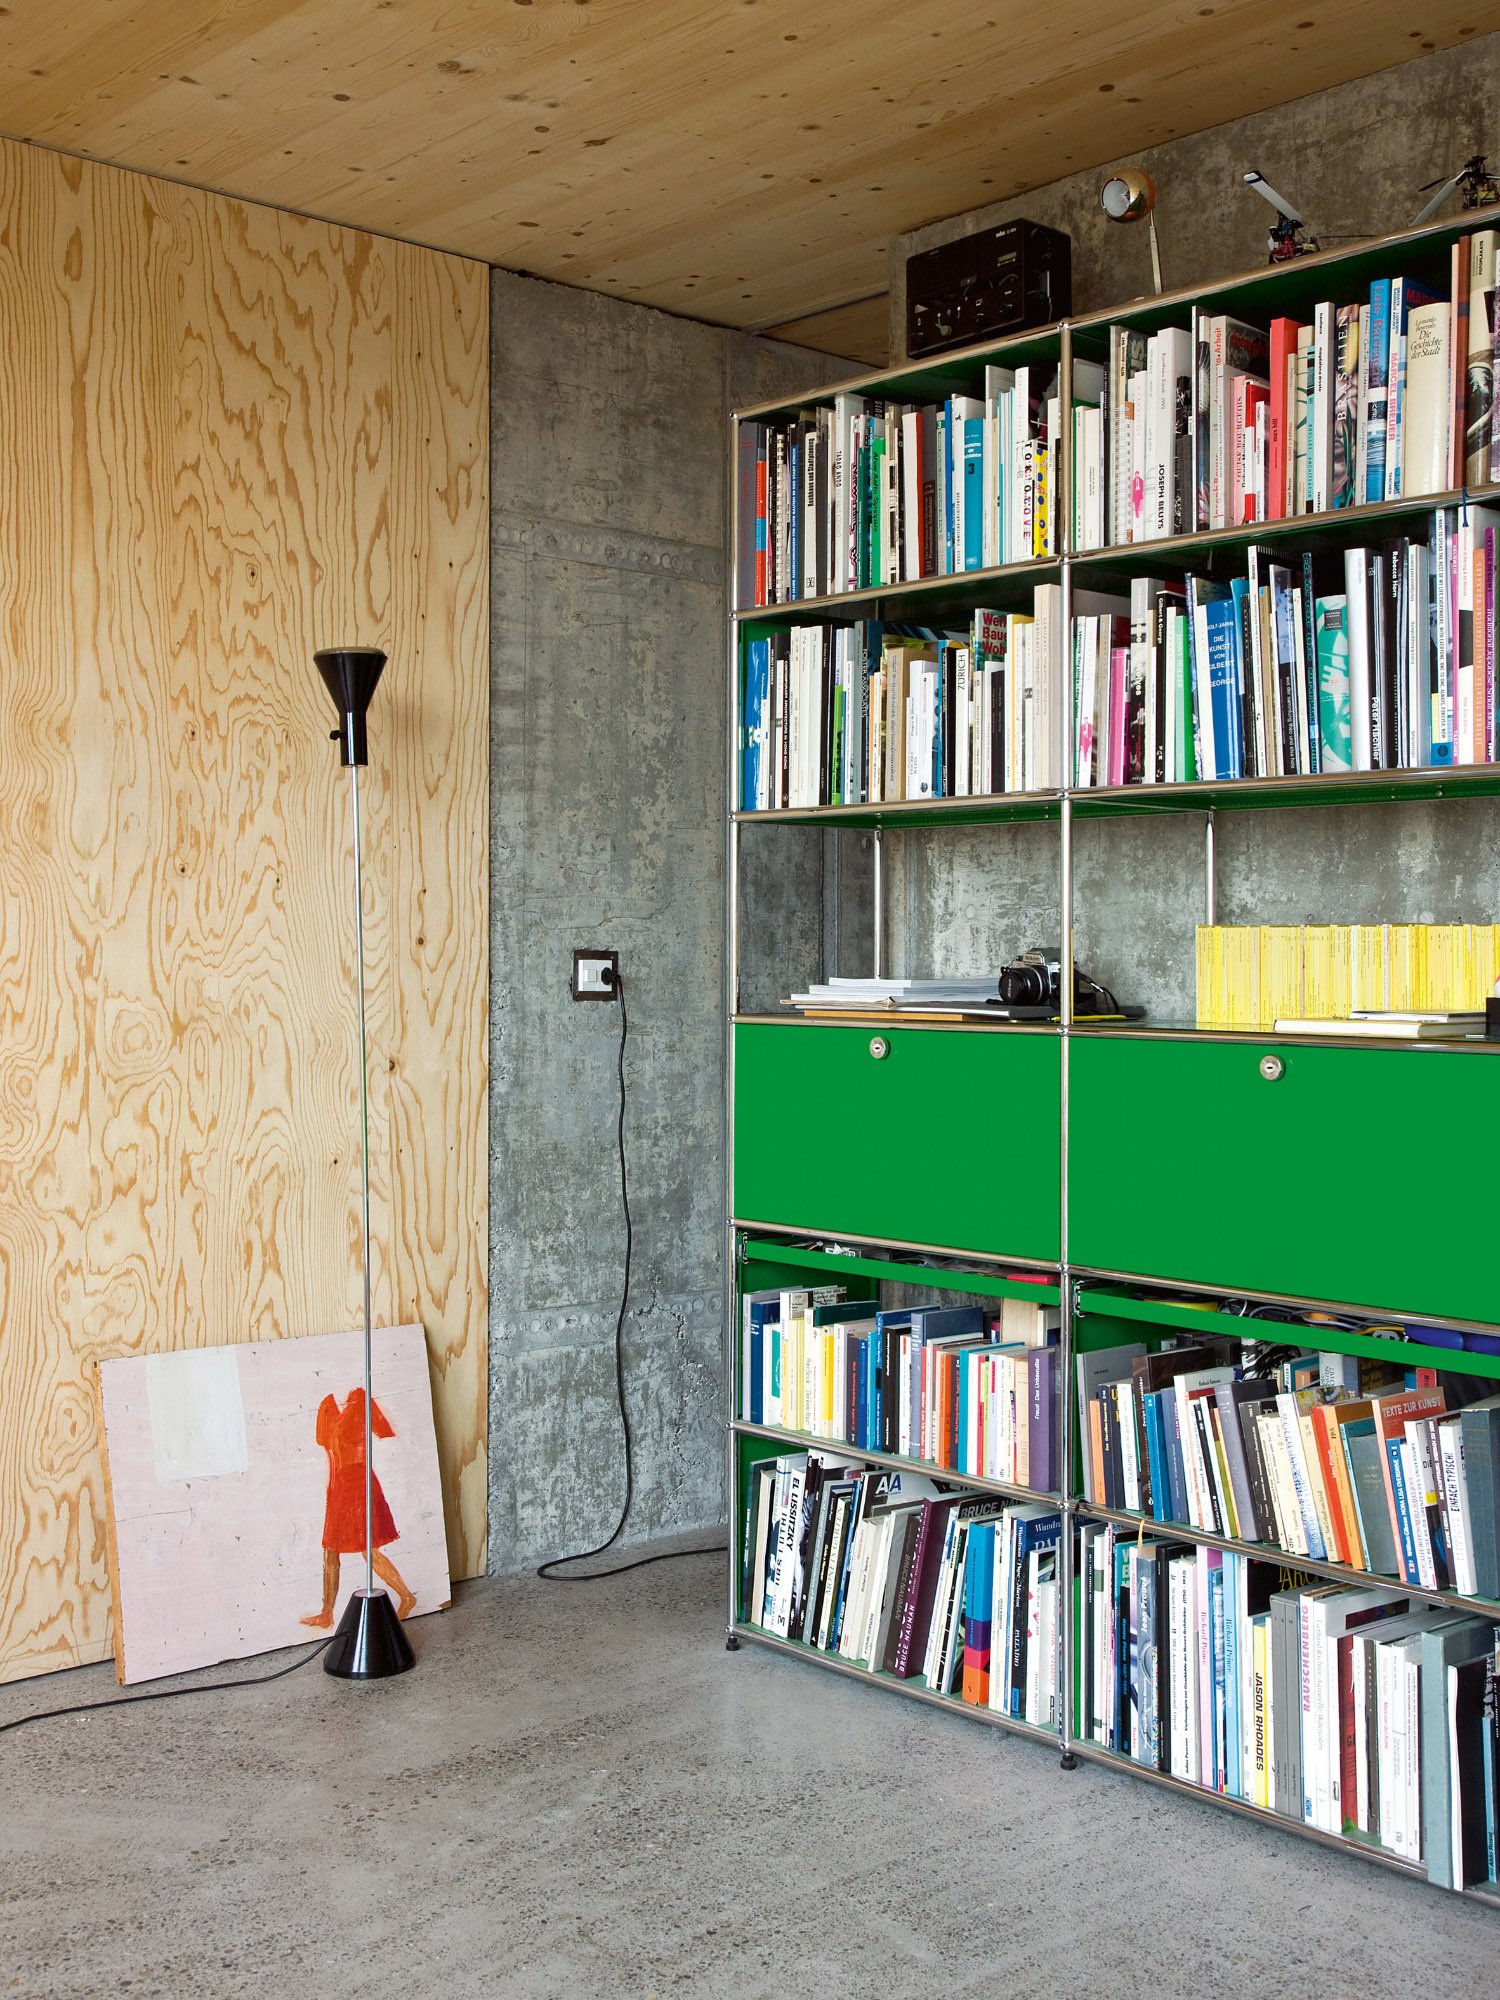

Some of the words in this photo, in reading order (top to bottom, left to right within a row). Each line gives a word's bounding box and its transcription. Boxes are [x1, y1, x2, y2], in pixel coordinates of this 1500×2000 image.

[1373, 286, 1385, 315] Luis
[1214, 327, 1222, 353] Arbeit
[1410, 337, 1443, 350] Geschichte
[1419, 329, 1432, 340] Die
[1337, 313, 1348, 421] BRASILIEN
[1389, 352, 1398, 397] MARCEL
[1388, 399, 1396, 441] BREUER
[968, 463, 975, 475] 3
[1157, 501, 1165, 530] BEUYS
[1209, 643, 1231, 652] KUNST
[957, 654, 966, 690] ZÜRICH
[1371, 697, 1379, 723] Peter
[1382, 1405, 1402, 1418] TEXTE
[1402, 1401, 1417, 1414] ZUR
[1417, 1396, 1442, 1411] KUNST
[1393, 1459, 1402, 1487] OVERDRIVE
[1444, 1452, 1456, 1482] TYPISCH!
[792, 1477, 800, 1489] EL
[1448, 1483, 1460, 1512] EINFACH
[788, 1493, 799, 1551] LISSITZKY
[962, 1501, 998, 1518] BRUCE
[825, 1553, 836, 1596] MONETS
[832, 1506, 843, 1551] GARTEN
[1140, 1576, 1150, 1612] Prouvé
[903, 1604, 915, 1642] NAUMAN
[1225, 1618, 1233, 1648] Richard
[899, 1643, 909, 1672] BRUCE
[1302, 1605, 1311, 1713] RAUSCHENBERG
[1255, 1672, 1263, 1712] JASON
[1256, 1715, 1264, 1771] RHOADES
